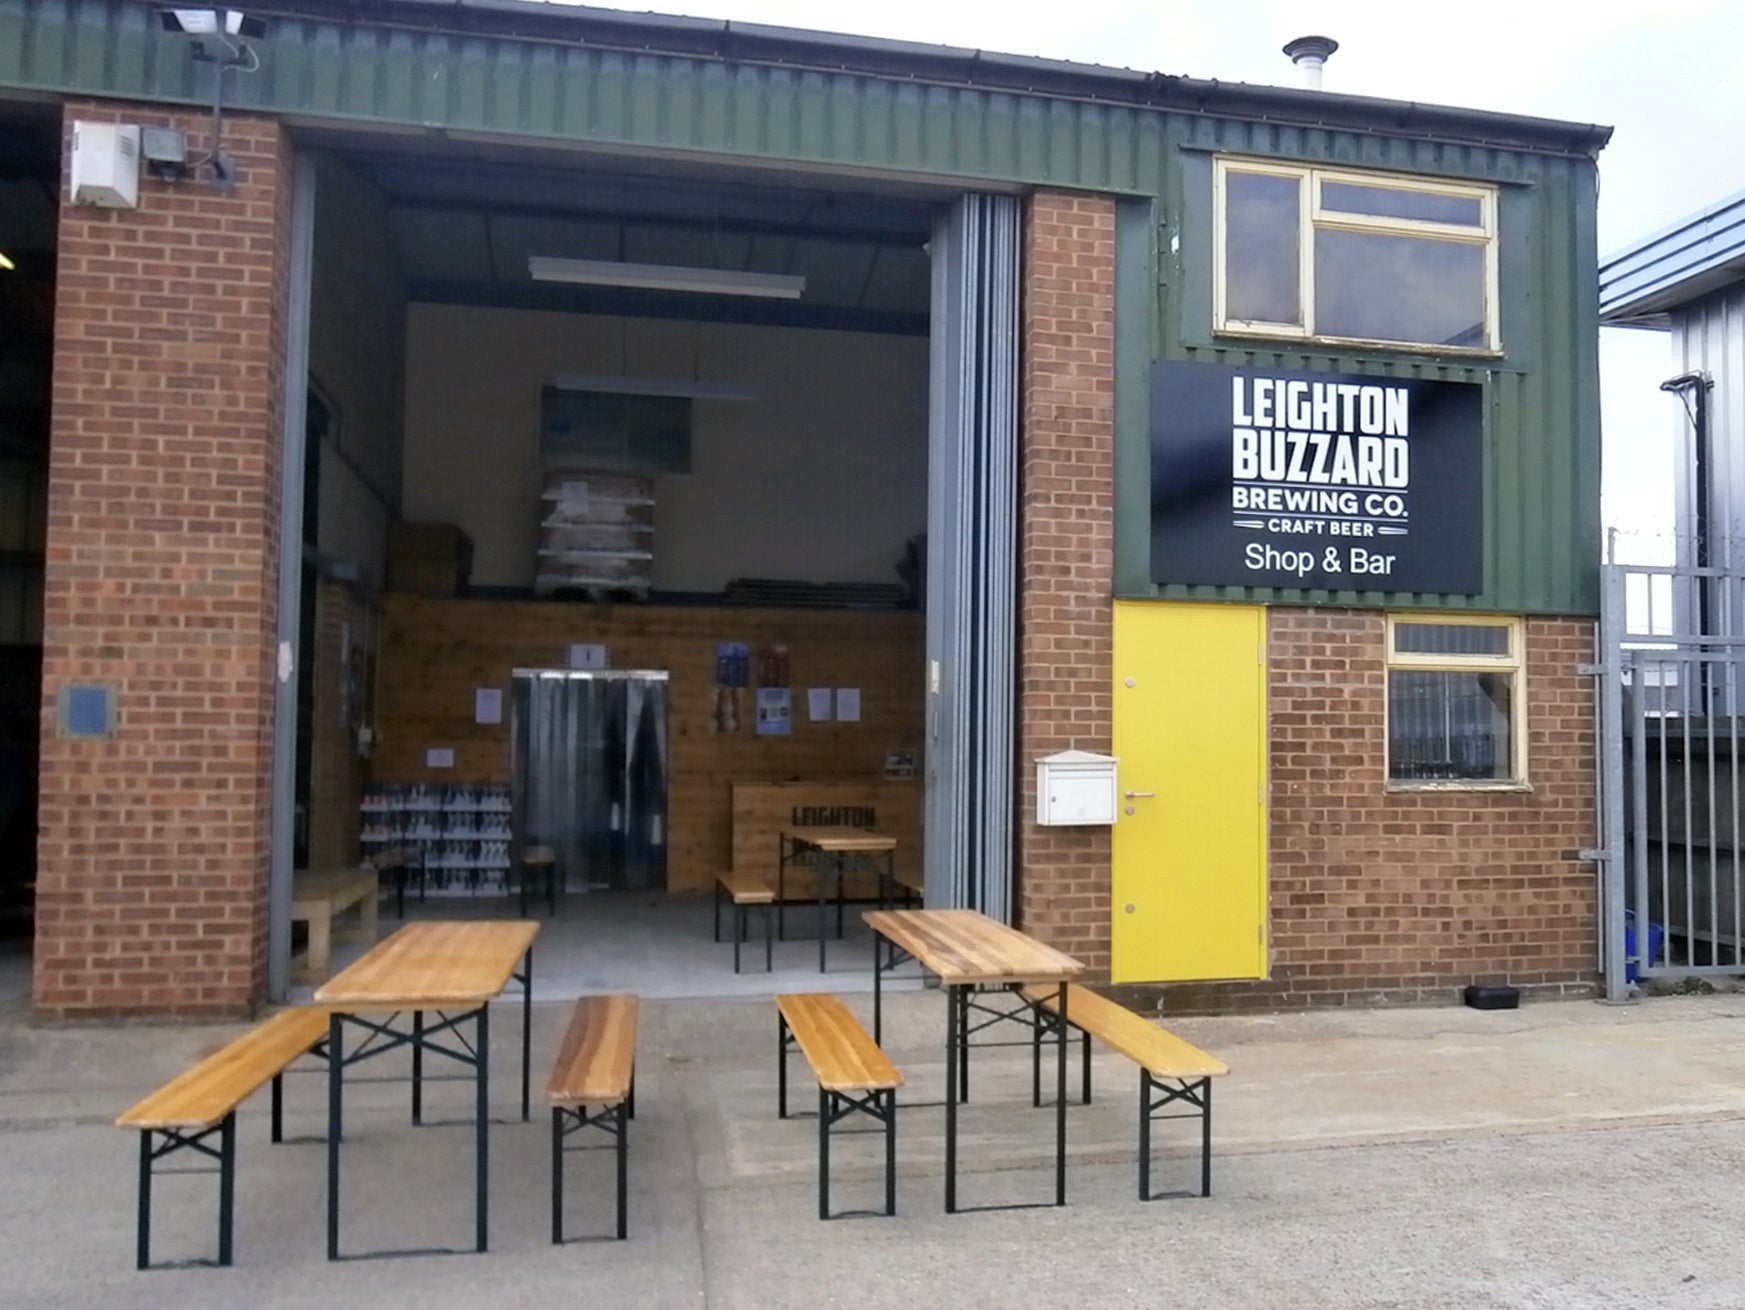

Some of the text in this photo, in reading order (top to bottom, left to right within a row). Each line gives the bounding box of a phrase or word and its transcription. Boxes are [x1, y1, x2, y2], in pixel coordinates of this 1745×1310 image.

[1232, 376, 1409, 437] LEIGHTON
[1232, 428, 1409, 488] BUZZARD
[1232, 486, 1409, 518] BREWING CO.
[1268, 518, 1374, 537] CRAFT BEER
[1245, 544, 1396, 577] Shop & Bar
[792, 806, 876, 828] LEIGHTON
